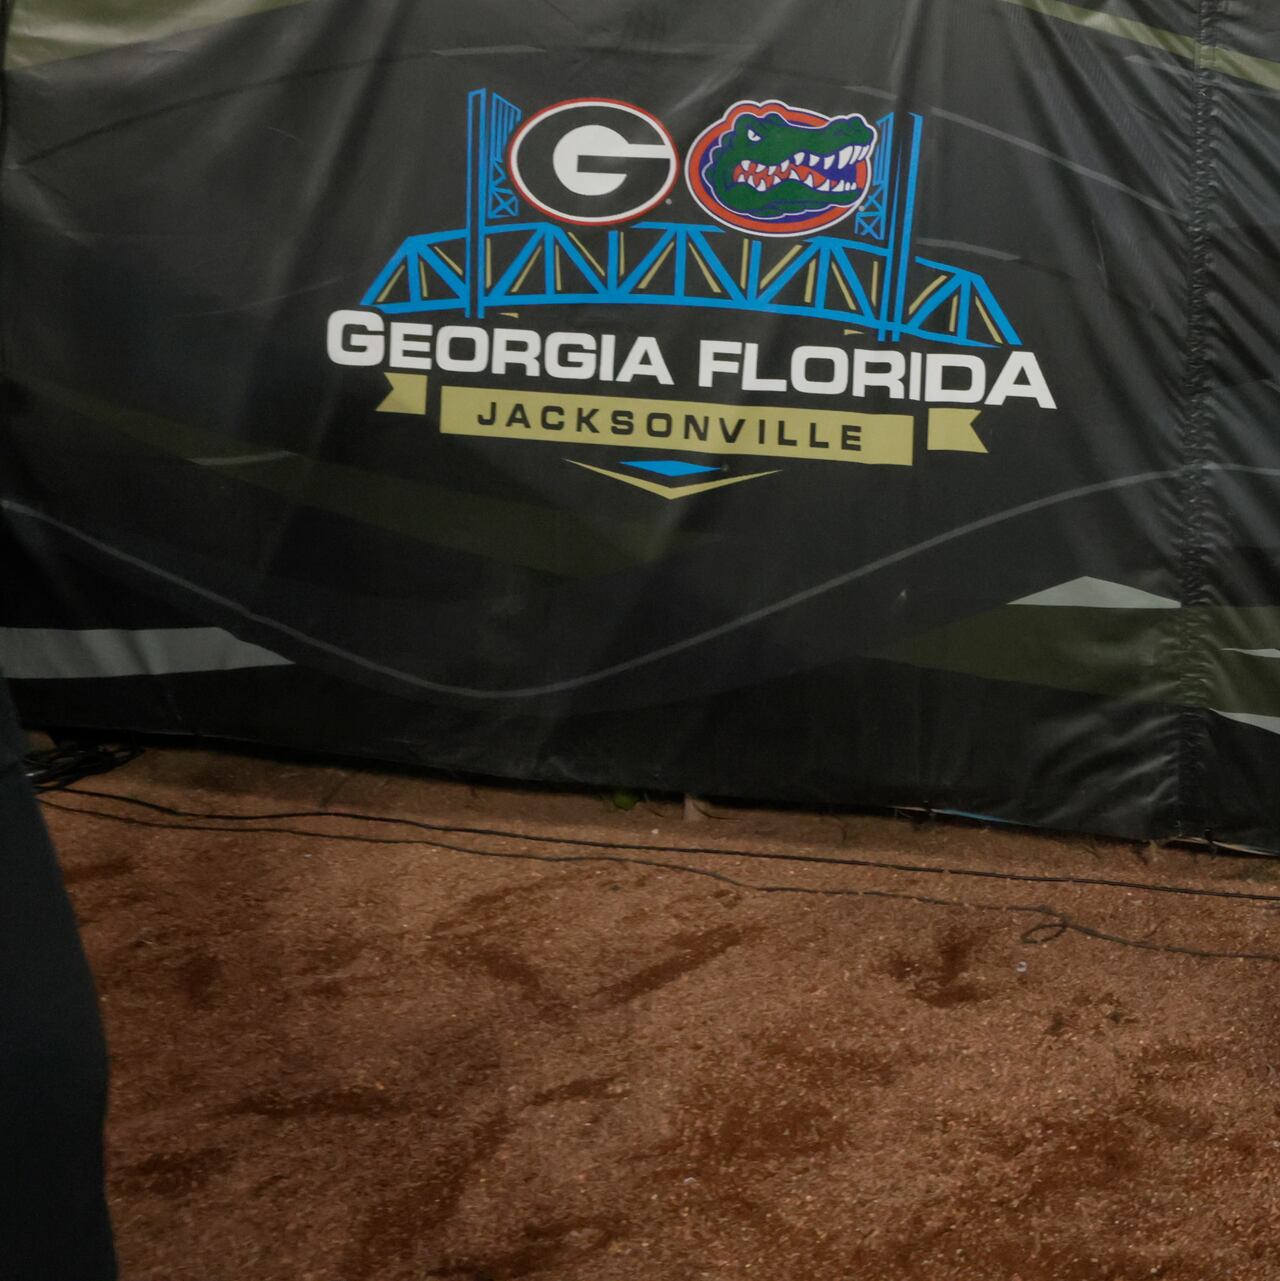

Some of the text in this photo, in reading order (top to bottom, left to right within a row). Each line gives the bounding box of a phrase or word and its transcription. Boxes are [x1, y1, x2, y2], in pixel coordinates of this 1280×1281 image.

[326, 309, 1057, 410] GEORGIA FLORIDA
[477, 401, 863, 452] JACKSONVILLE
